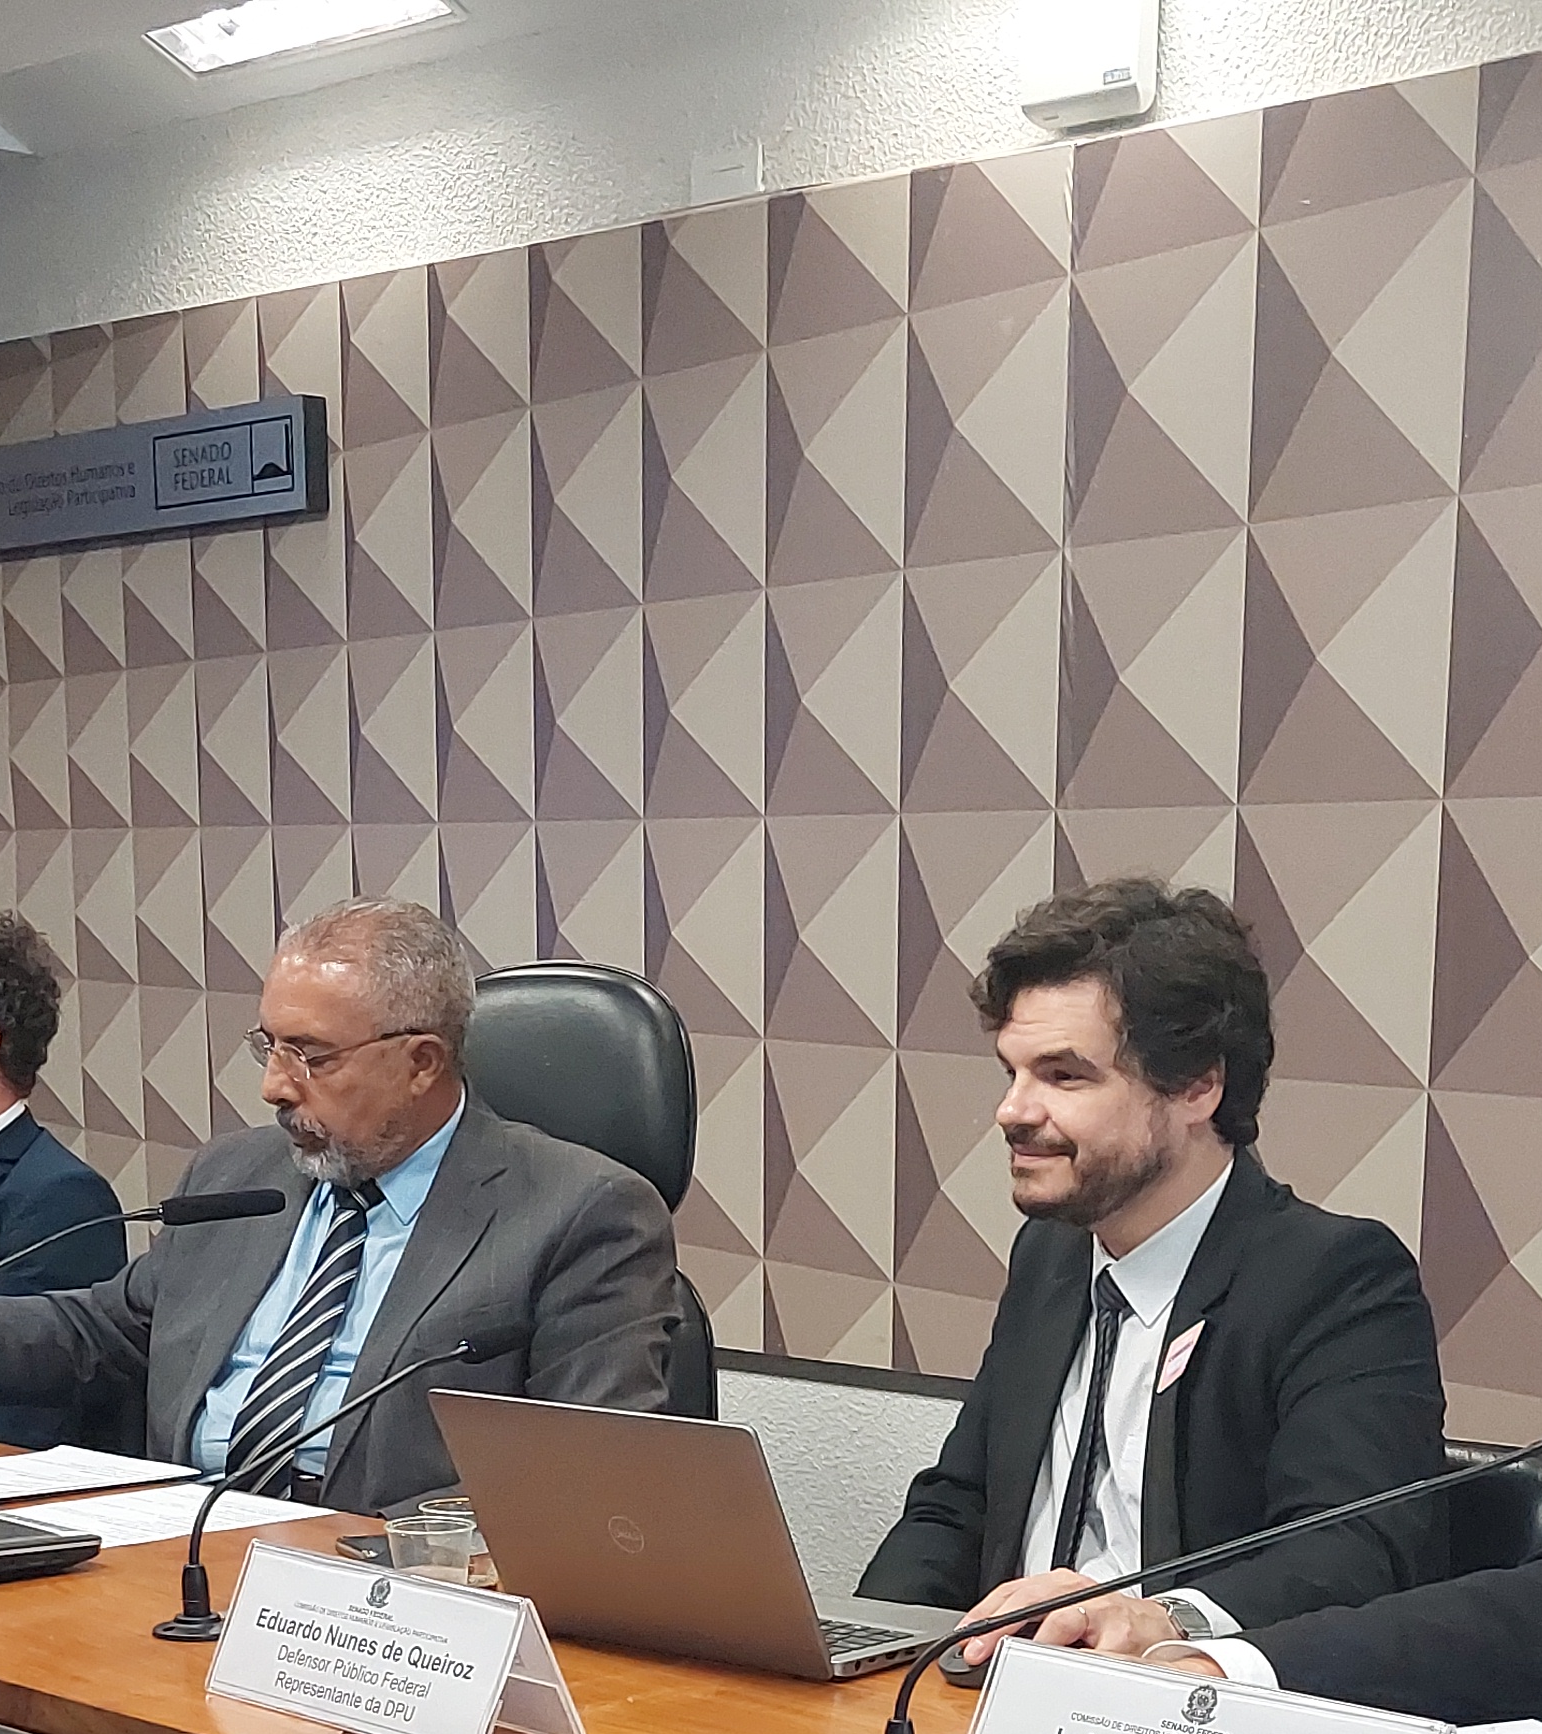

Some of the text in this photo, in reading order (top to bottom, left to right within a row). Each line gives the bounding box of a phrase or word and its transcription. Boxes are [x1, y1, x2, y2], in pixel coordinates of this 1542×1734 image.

[173, 441, 233, 468] SENADO
[173, 466, 233, 491] FEDERAL
[256, 1607, 475, 1681] Eduardo Nunes de Queiroz
[277, 1645, 431, 1699] Defensor Público Federal
[275, 1672, 416, 1723] Representante da DPU
[1112, 1720, 1123, 1731] DE
[1160, 1719, 1195, 1734] SENADO
